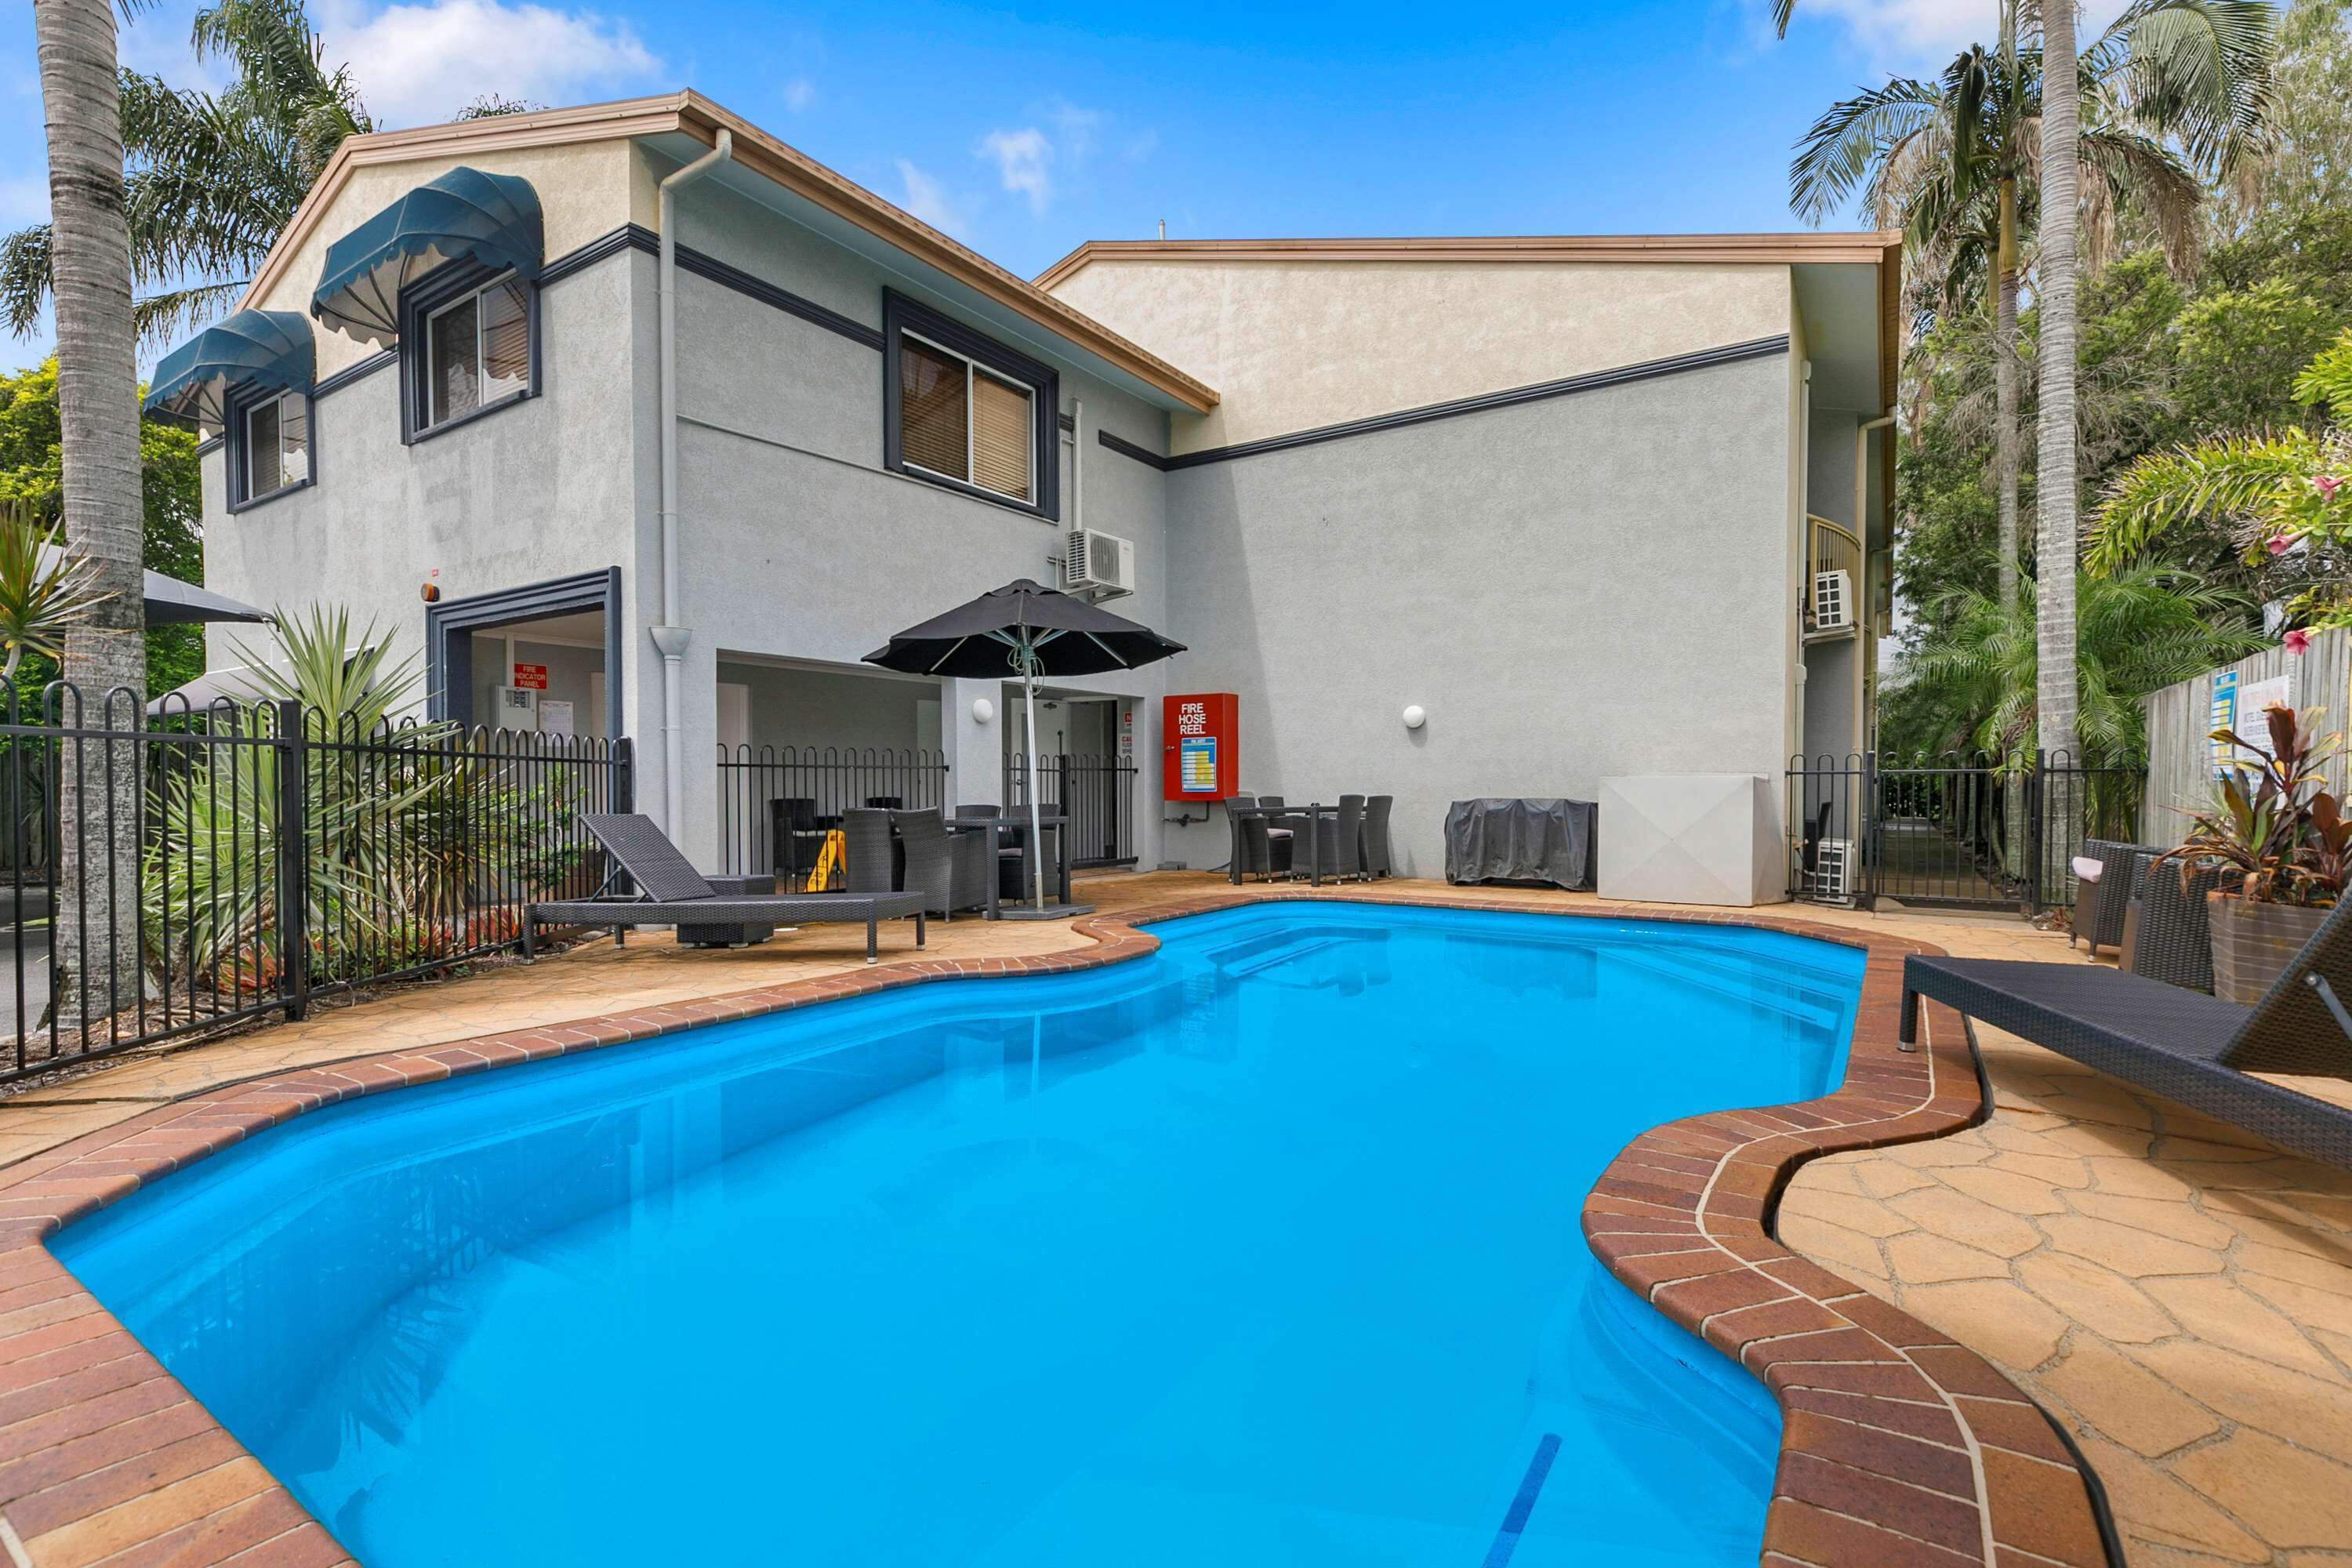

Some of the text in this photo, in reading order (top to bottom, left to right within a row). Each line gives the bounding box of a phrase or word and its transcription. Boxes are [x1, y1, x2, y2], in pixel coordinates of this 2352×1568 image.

[520, 680, 539, 688] PANEL
[1181, 702, 1204, 713] FIRE
[1178, 713, 1207, 724] HOSE
[1180, 724, 1206, 735] REEL
